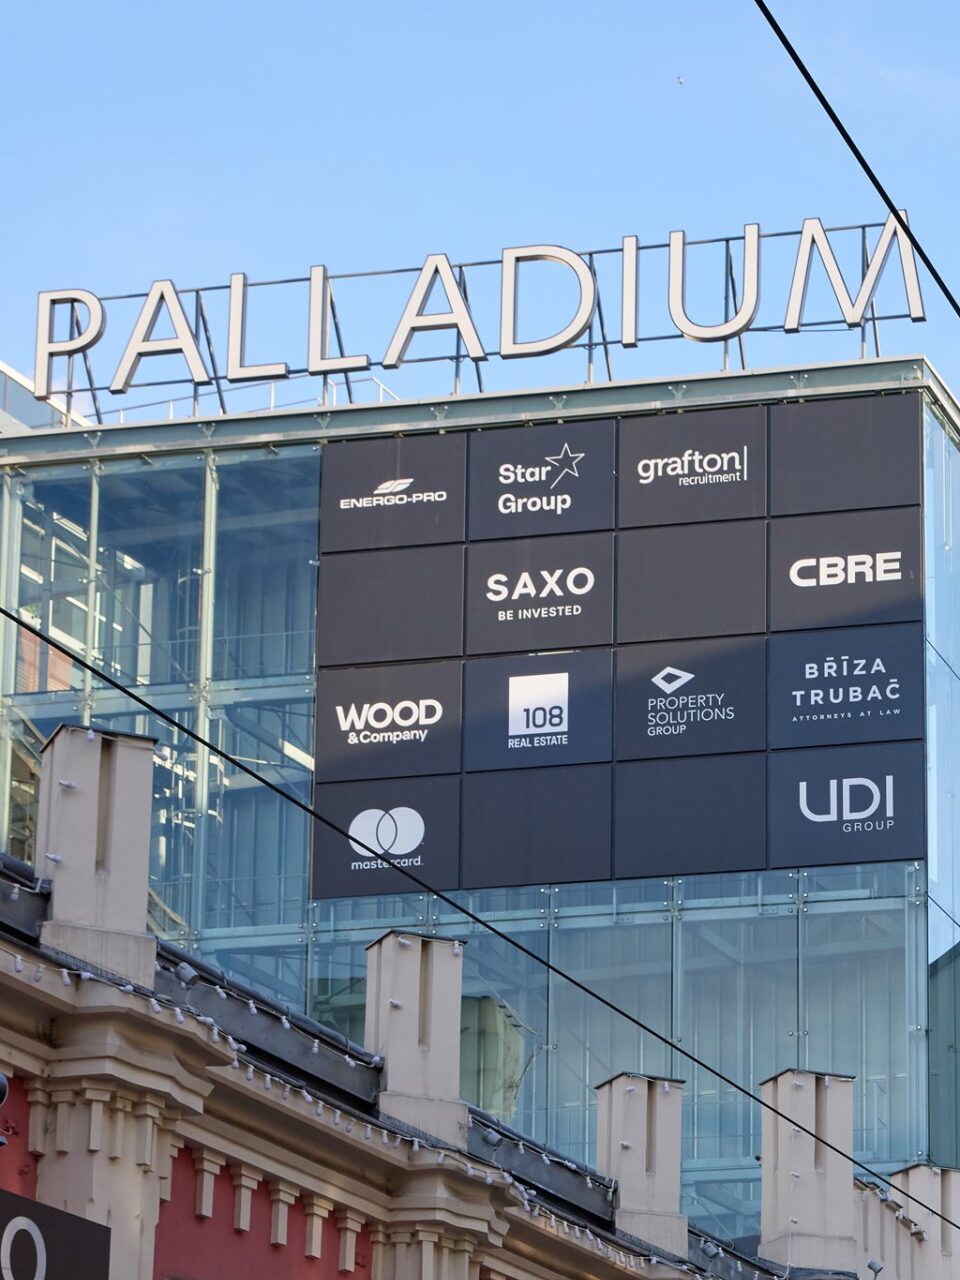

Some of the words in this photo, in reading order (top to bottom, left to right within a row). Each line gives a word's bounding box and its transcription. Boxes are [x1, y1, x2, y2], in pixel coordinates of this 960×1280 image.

[34, 209, 927, 400] PALLADIUM
[498, 463, 552, 485] Star
[637, 449, 742, 485] grafton
[678, 471, 741, 486] recruitment
[339, 490, 447, 509] ENERGO-PRO
[498, 492, 572, 515] Group
[788, 551, 902, 588] CBRE
[485, 566, 595, 602] SAXO
[498, 609, 514, 621] BE
[518, 604, 582, 620] INVESTED
[647, 692, 725, 711] PROPERTY
[335, 698, 443, 731] WOOD
[523, 704, 564, 729] 108
[647, 706, 735, 726] SOLUTIONS
[792, 712, 853, 723] ATTORNEYS
[859, 710, 872, 718] AT
[879, 708, 901, 717] LAW
[507, 736, 532, 749] REAL
[534, 734, 569, 747] ESTATE
[647, 725, 687, 737] GROUP
[799, 774, 894, 823] UDI
[842, 820, 895, 833] GROUP
